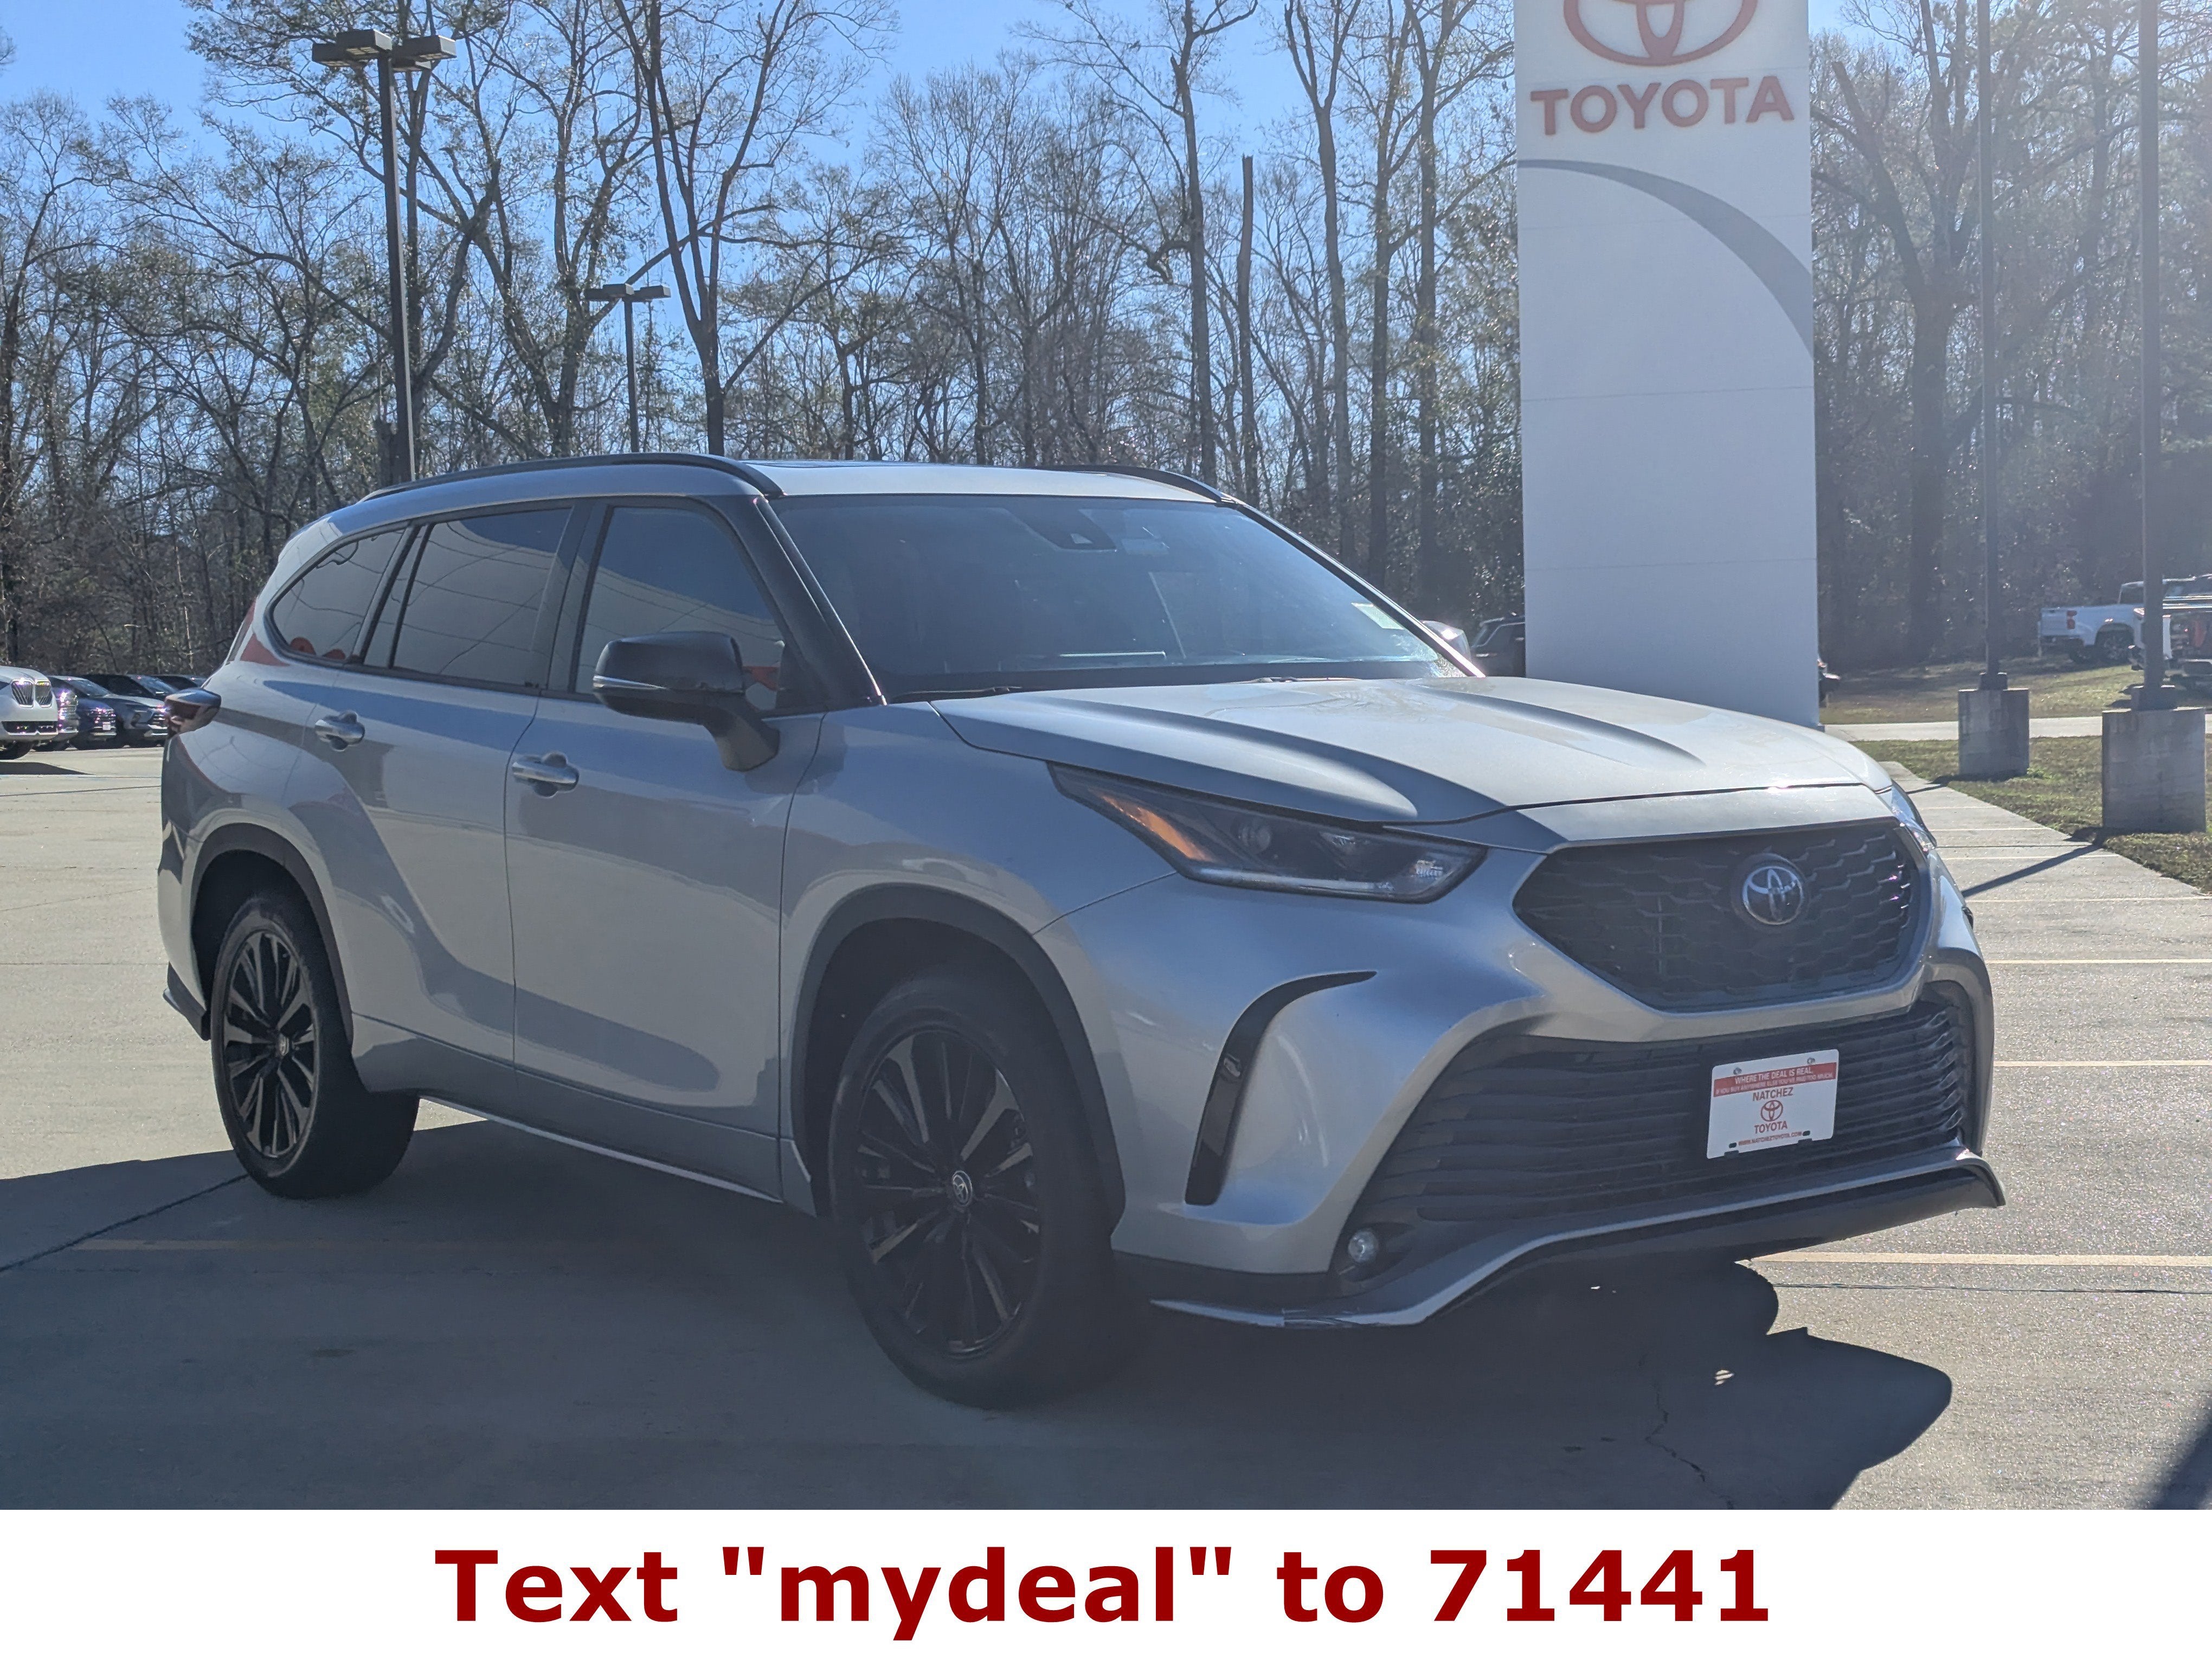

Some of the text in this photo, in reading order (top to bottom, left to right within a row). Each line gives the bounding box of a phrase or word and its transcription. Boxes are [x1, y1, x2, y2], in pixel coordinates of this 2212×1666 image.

[1530, 75, 1795, 136] TOYOTA
[1735, 1074, 1757, 1084] WHERE
[1758, 1072, 1769, 1081] THE
[1771, 1070, 1787, 1079] DEAL
[1752, 1087, 1793, 1101] NATCHEZ
[1754, 1120, 1788, 1134] TOYOTA
